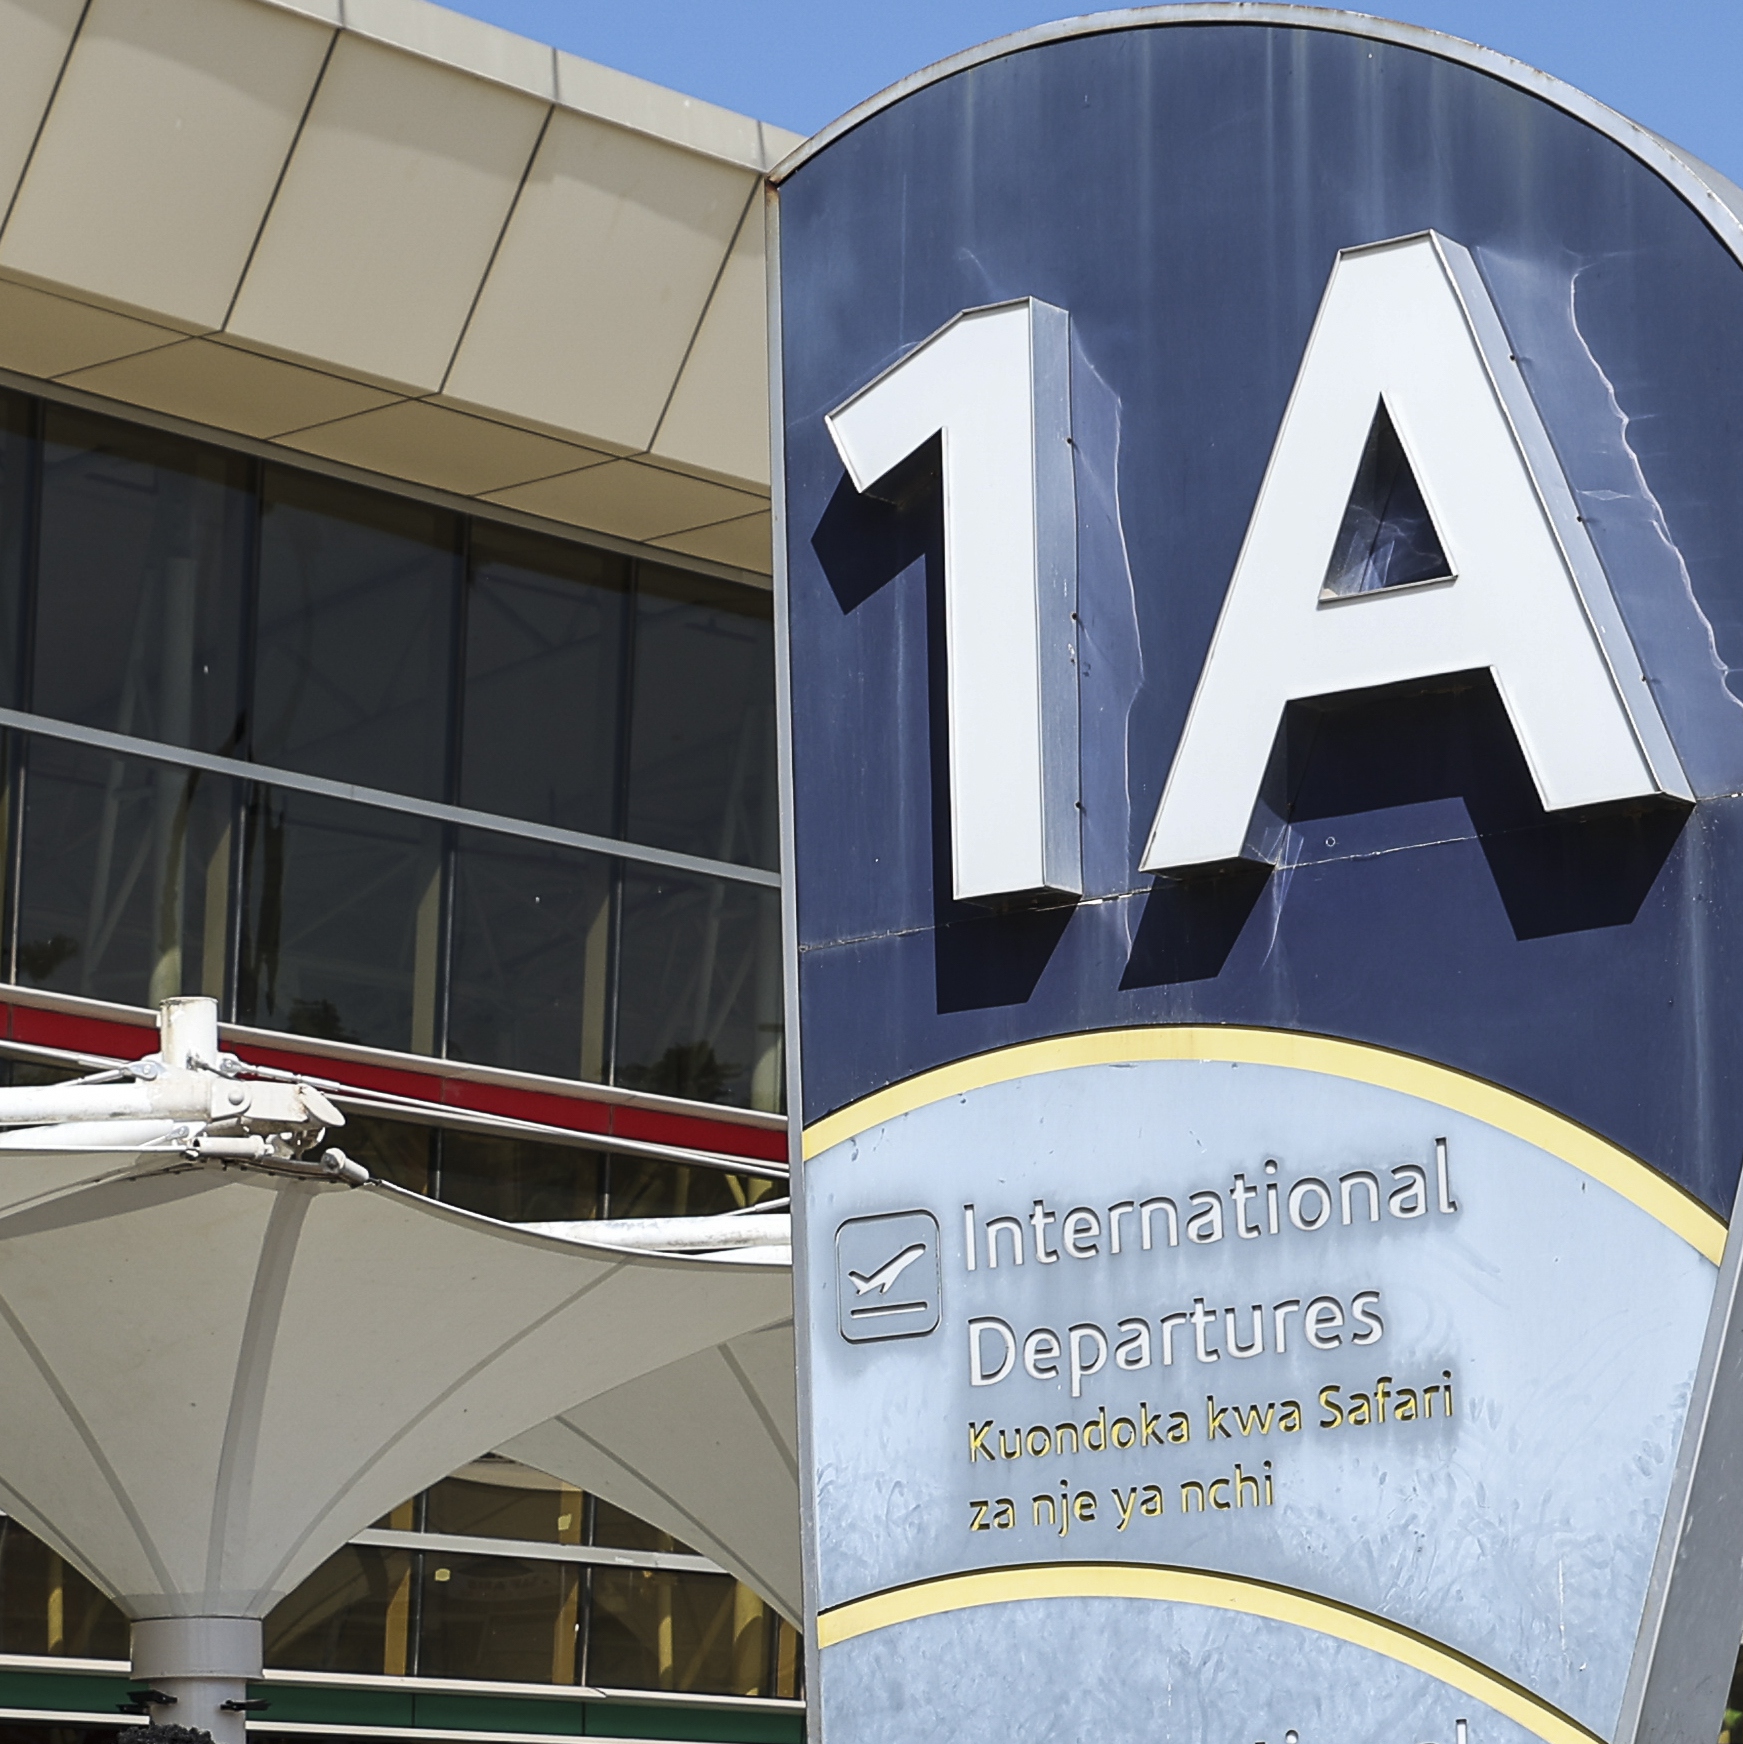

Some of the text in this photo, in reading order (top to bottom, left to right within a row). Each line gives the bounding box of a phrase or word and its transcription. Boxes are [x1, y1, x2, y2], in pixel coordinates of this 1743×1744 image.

[824, 229, 1696, 902] 1A
[963, 1137, 1458, 1271] International
[967, 1290, 1385, 1398] Departures
[968, 1370, 1453, 1463] Kuondoka kwa Safari
[969, 1460, 1274, 1538] za nje ya nchi
